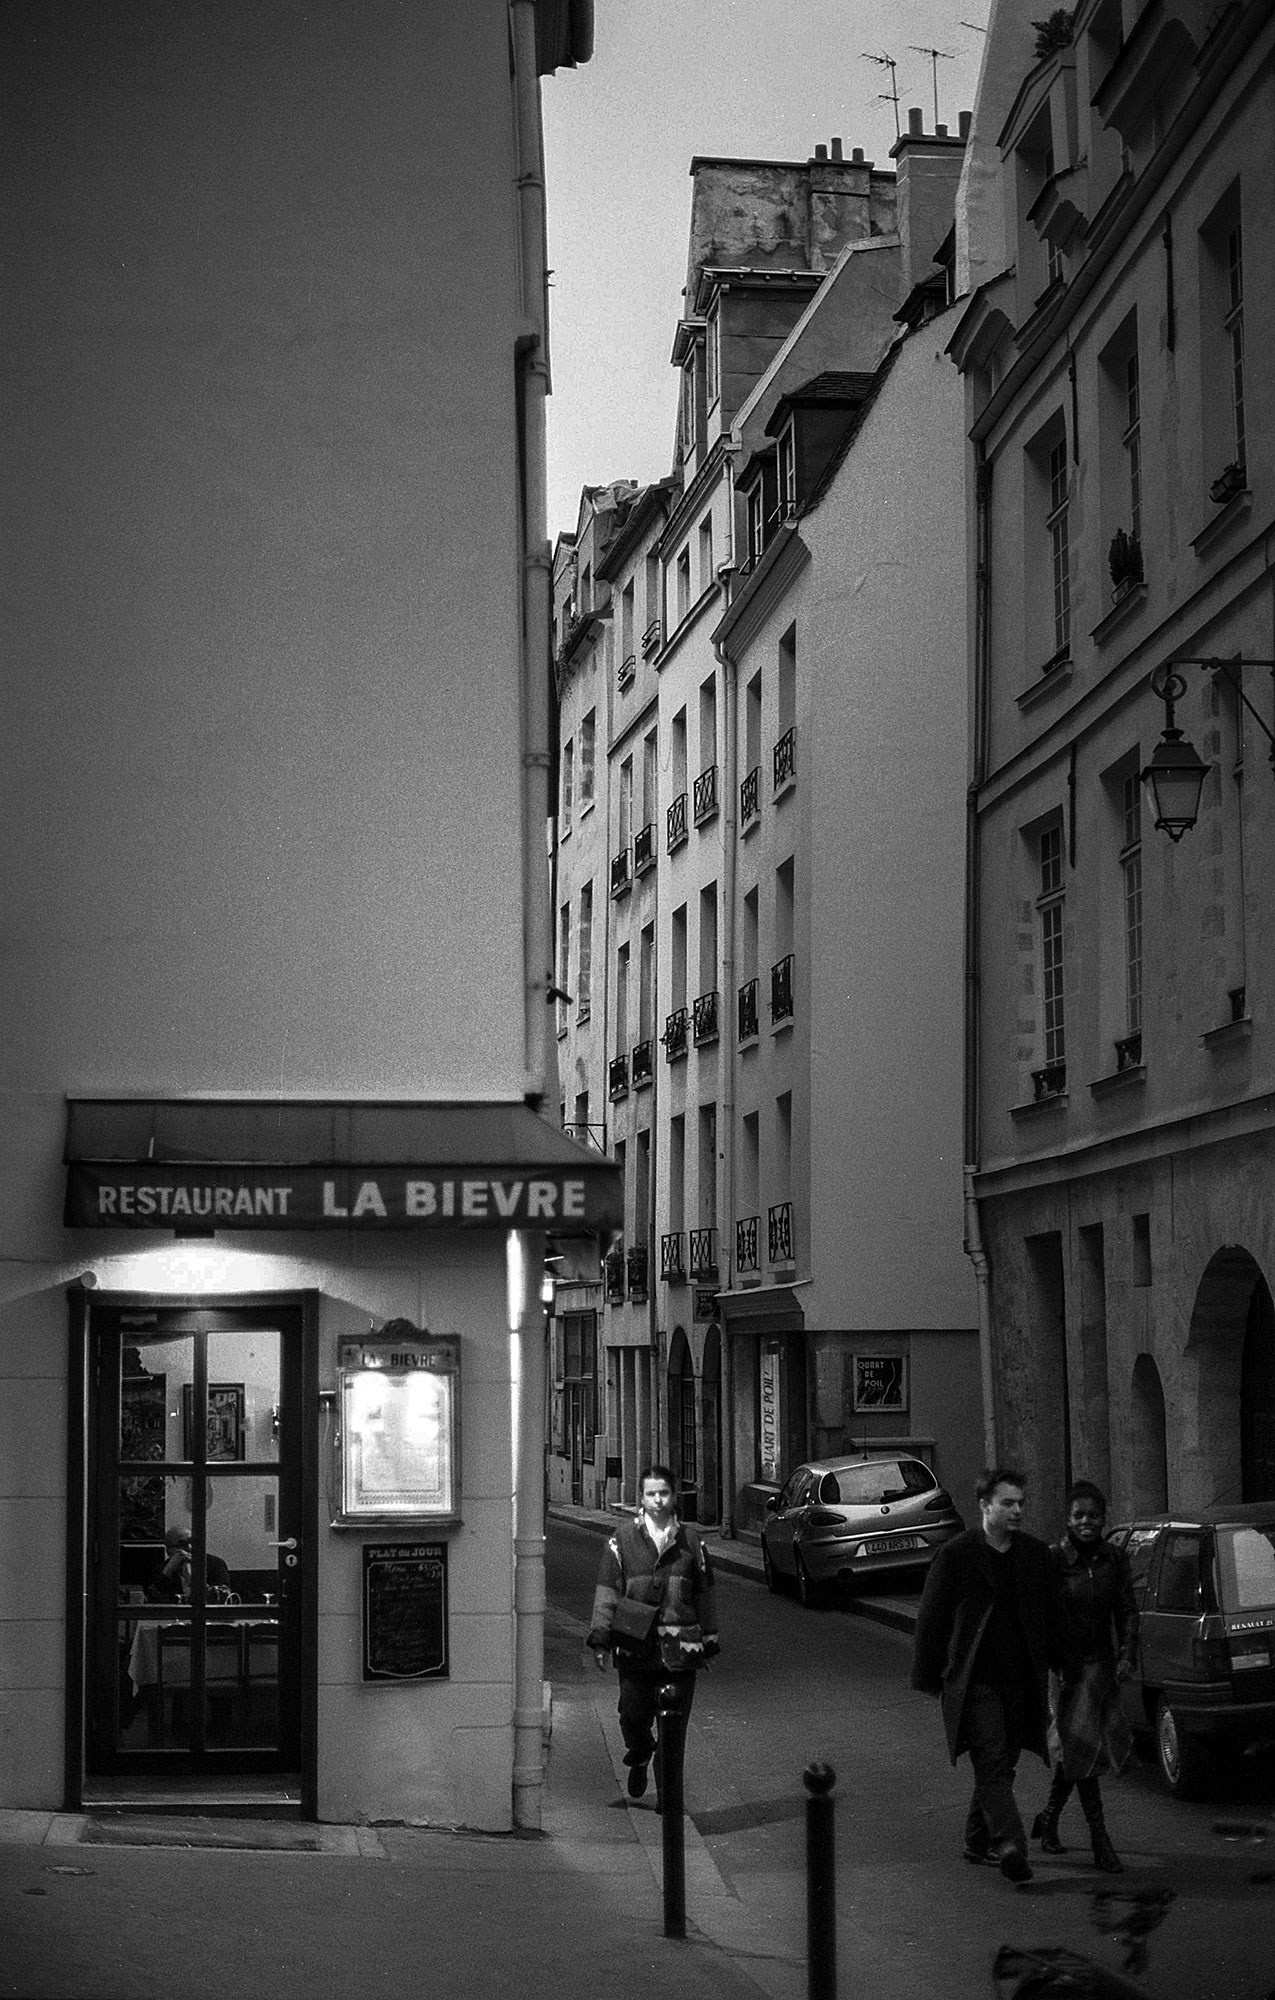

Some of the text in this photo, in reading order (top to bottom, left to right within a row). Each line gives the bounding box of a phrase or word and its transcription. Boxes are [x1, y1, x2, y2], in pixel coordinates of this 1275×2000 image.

[99, 1180, 586, 1218] RESTAURANT LA BIEVRE
[390, 1352, 436, 1367] BIEVRE
[864, 1379, 884, 1387] POIL
[763, 1406, 775, 1425] DE
[368, 1548, 397, 1559] PLAT
[411, 1546, 442, 1557] JOUR
[1232, 1621, 1264, 1630] RENAULT
